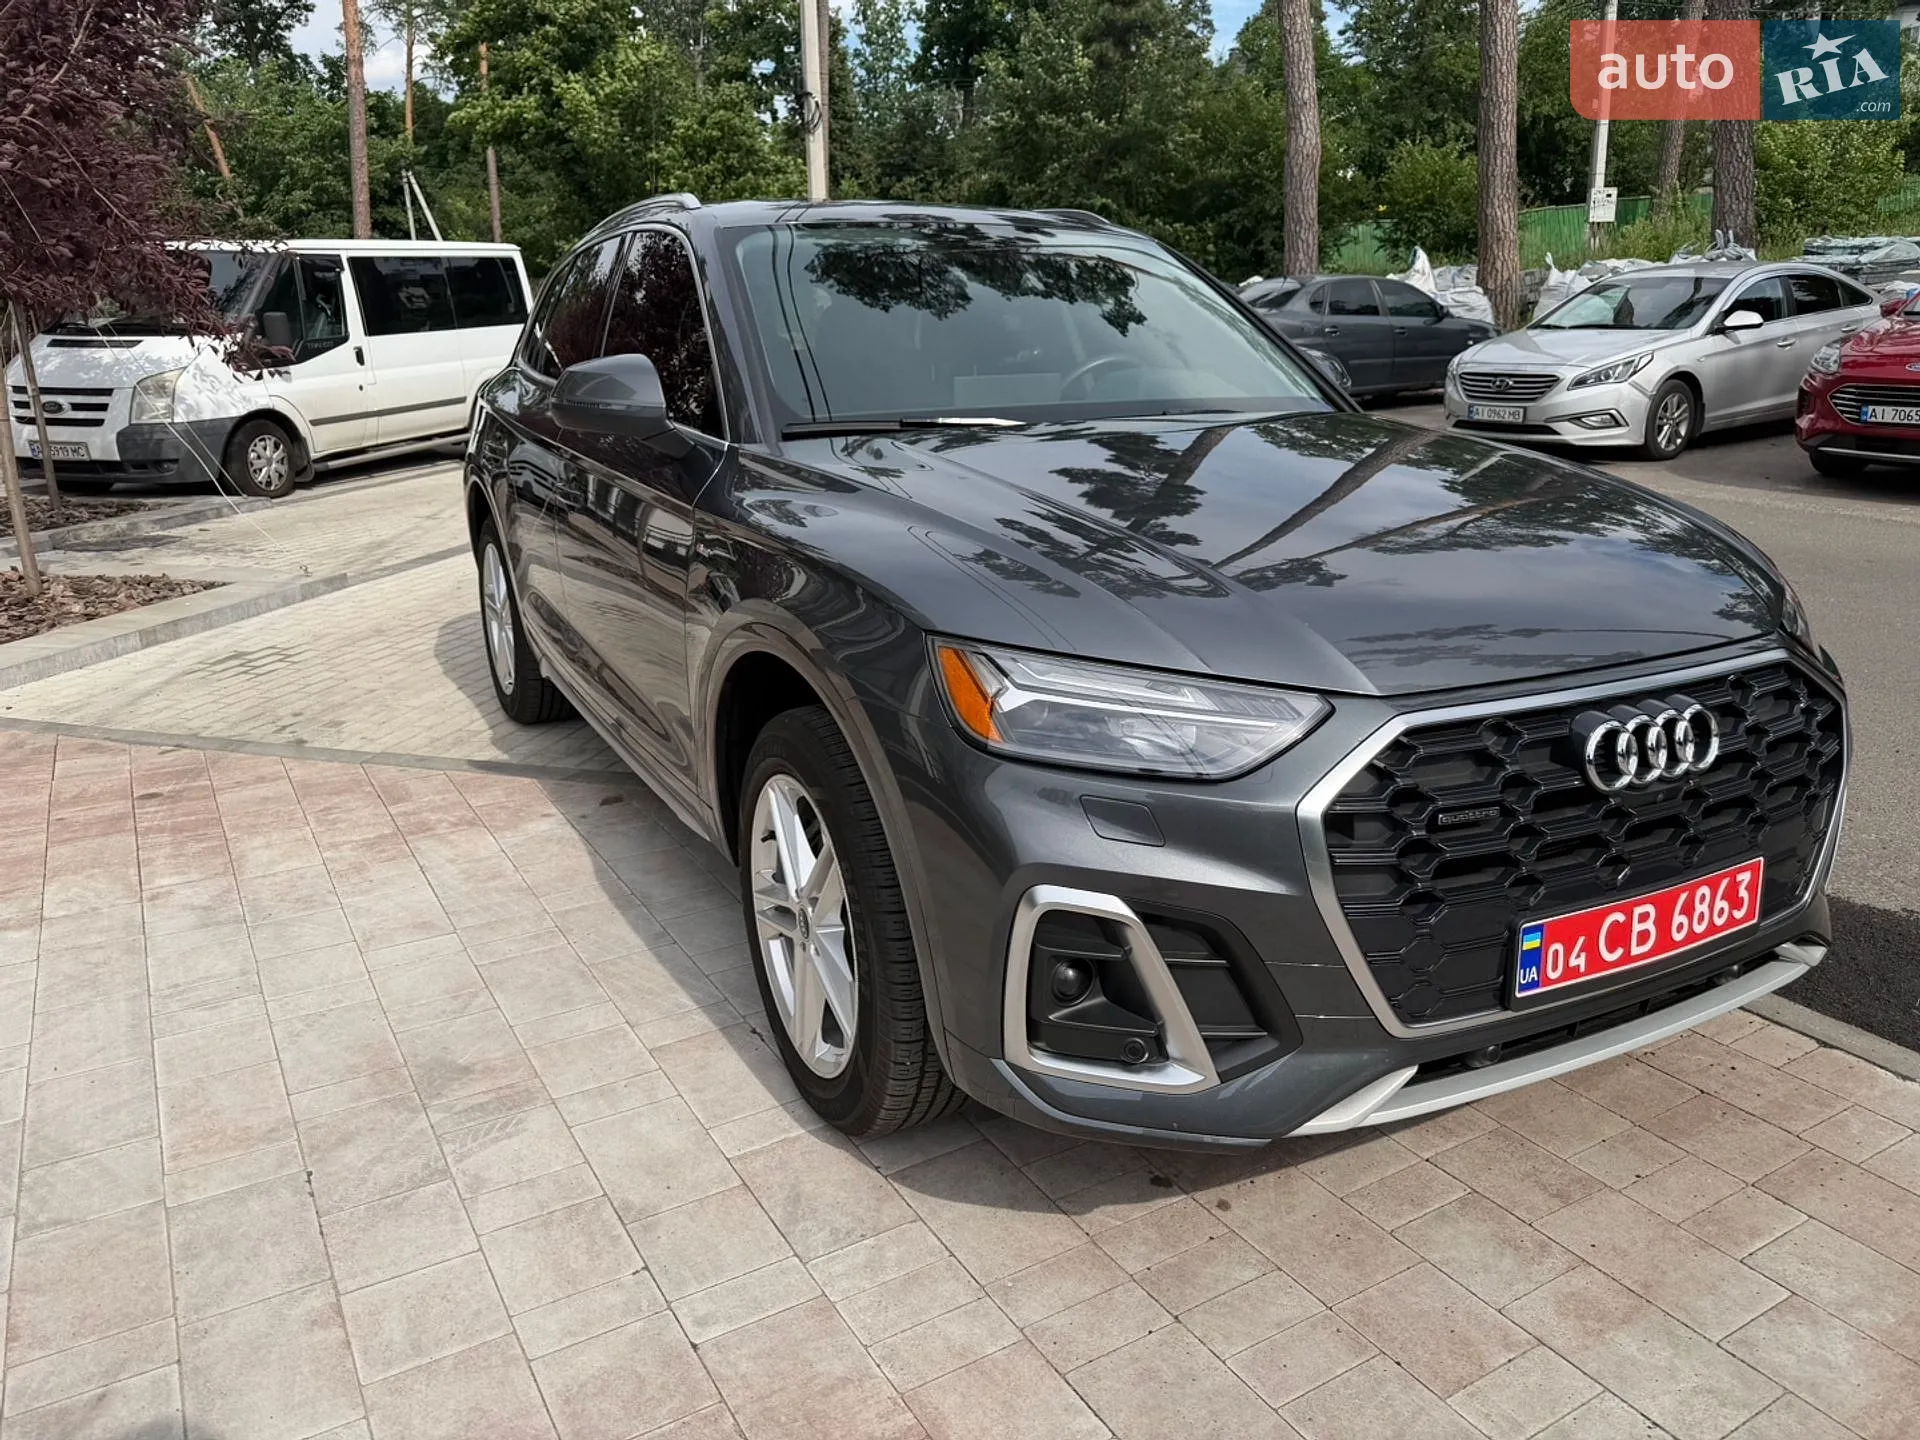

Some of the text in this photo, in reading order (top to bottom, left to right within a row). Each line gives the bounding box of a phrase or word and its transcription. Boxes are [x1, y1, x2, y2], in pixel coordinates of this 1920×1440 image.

[1869, 408, 1920, 422] AI 7065
[1546, 871, 1752, 980] 04 CB 6863
[1520, 966, 1538, 984] UA
